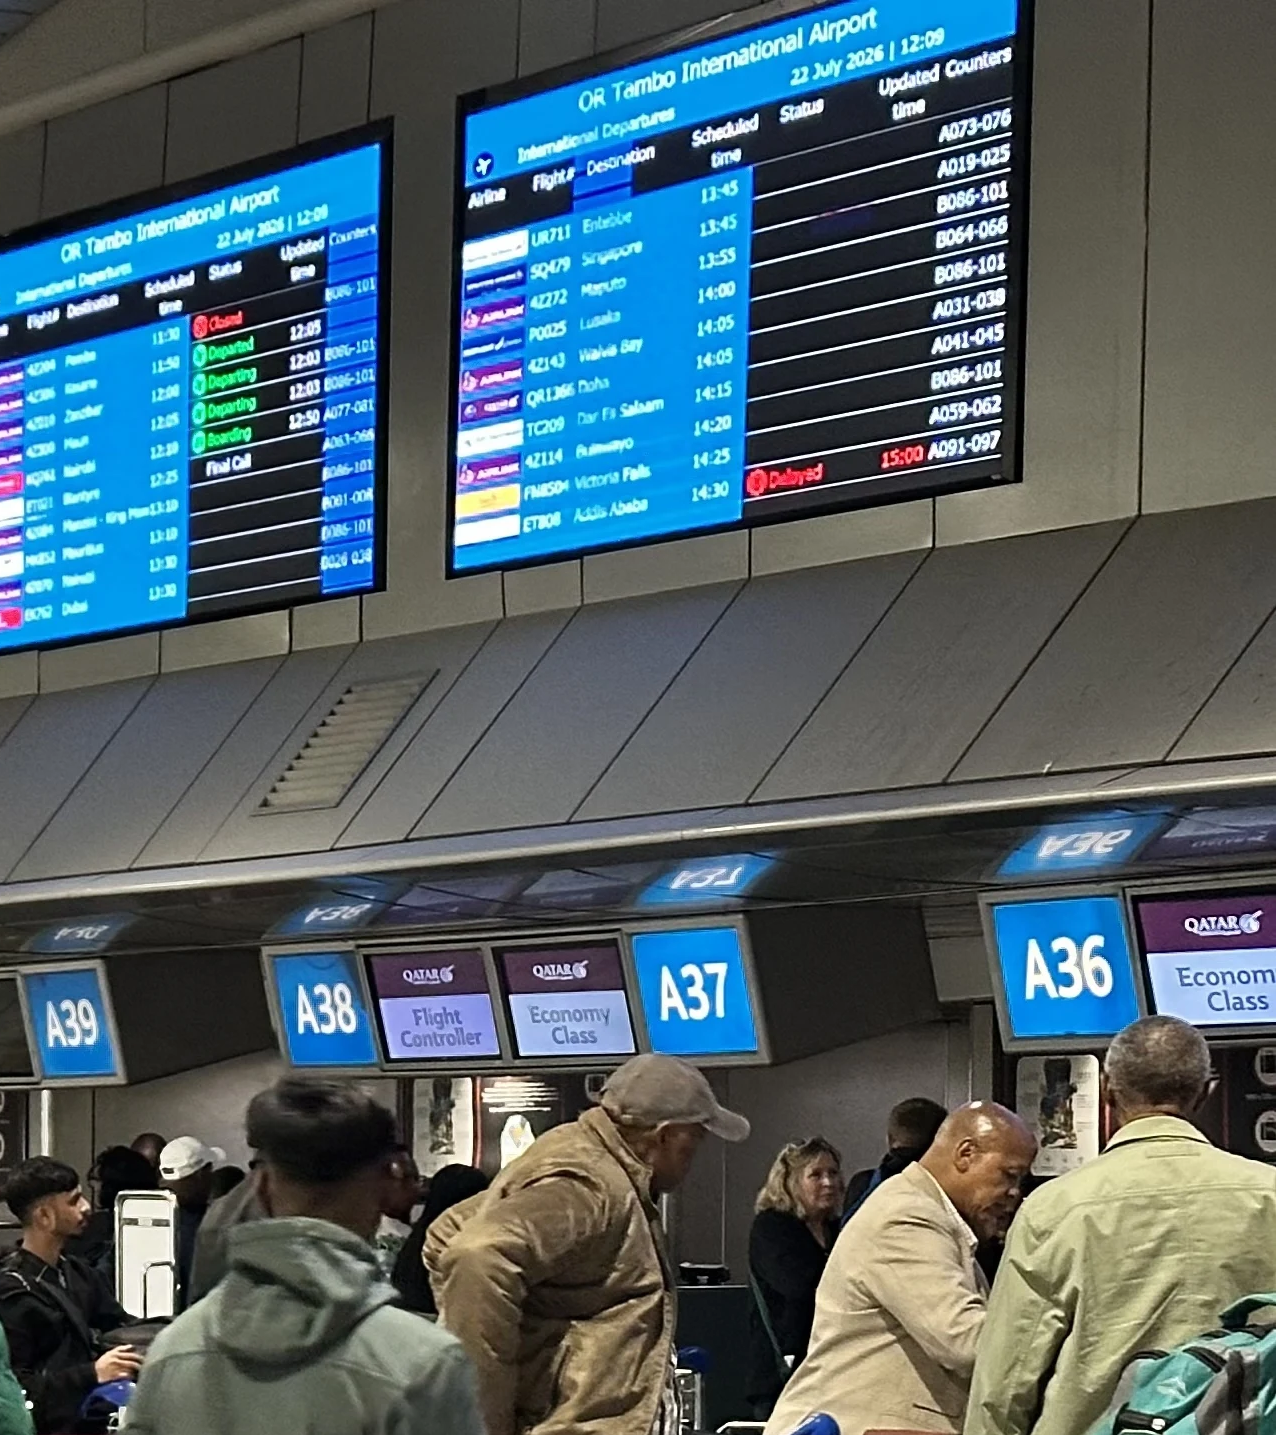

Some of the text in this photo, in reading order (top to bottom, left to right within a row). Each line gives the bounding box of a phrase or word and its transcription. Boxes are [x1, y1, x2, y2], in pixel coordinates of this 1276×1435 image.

[578, 8, 879, 113] OR Tambo International Airport
[790, 67, 810, 86] 22
[812, 60, 843, 80] July
[846, 44, 885, 70] 2026
[469, 47, 1012, 210] Airline Destination Scheduled Status Updated Counters
[518, 107, 676, 164] International Departures
[711, 98, 926, 169] time time
[530, 107, 1012, 247] UR711 A073-076
[936, 180, 1009, 214] B086-101
[86, 229, 133, 257] Tambo
[136, 201, 225, 242] International
[229, 185, 280, 216] Airport
[581, 241, 643, 267] Singapore
[936, 143, 1011, 179] A019-025
[697, 252, 1006, 337] 14:05 B086-101
[289, 379, 321, 401] 12:03
[694, 359, 1002, 437] 14:20 B086-101
[695, 381, 733, 403] 14:15
[289, 409, 320, 431] 12:50
[693, 395, 1002, 469] 14:25 A059-062
[692, 430, 1002, 502] 14:30 15:00 A091-097
[1183, 914, 1239, 937] QATAR
[403, 967, 440, 983] QATAR
[532, 963, 573, 979] QATAR
[659, 961, 730, 1022] A37
[1024, 933, 1114, 1001] A36
[1175, 966, 1276, 987] Econom
[44, 998, 100, 1049] A39
[297, 983, 358, 1035] A38
[411, 1006, 463, 1031] Flight
[528, 1005, 612, 1027] Economy
[1207, 990, 1270, 1012] Class
[399, 1029, 484, 1049] Controller
[551, 1025, 599, 1046] Class
